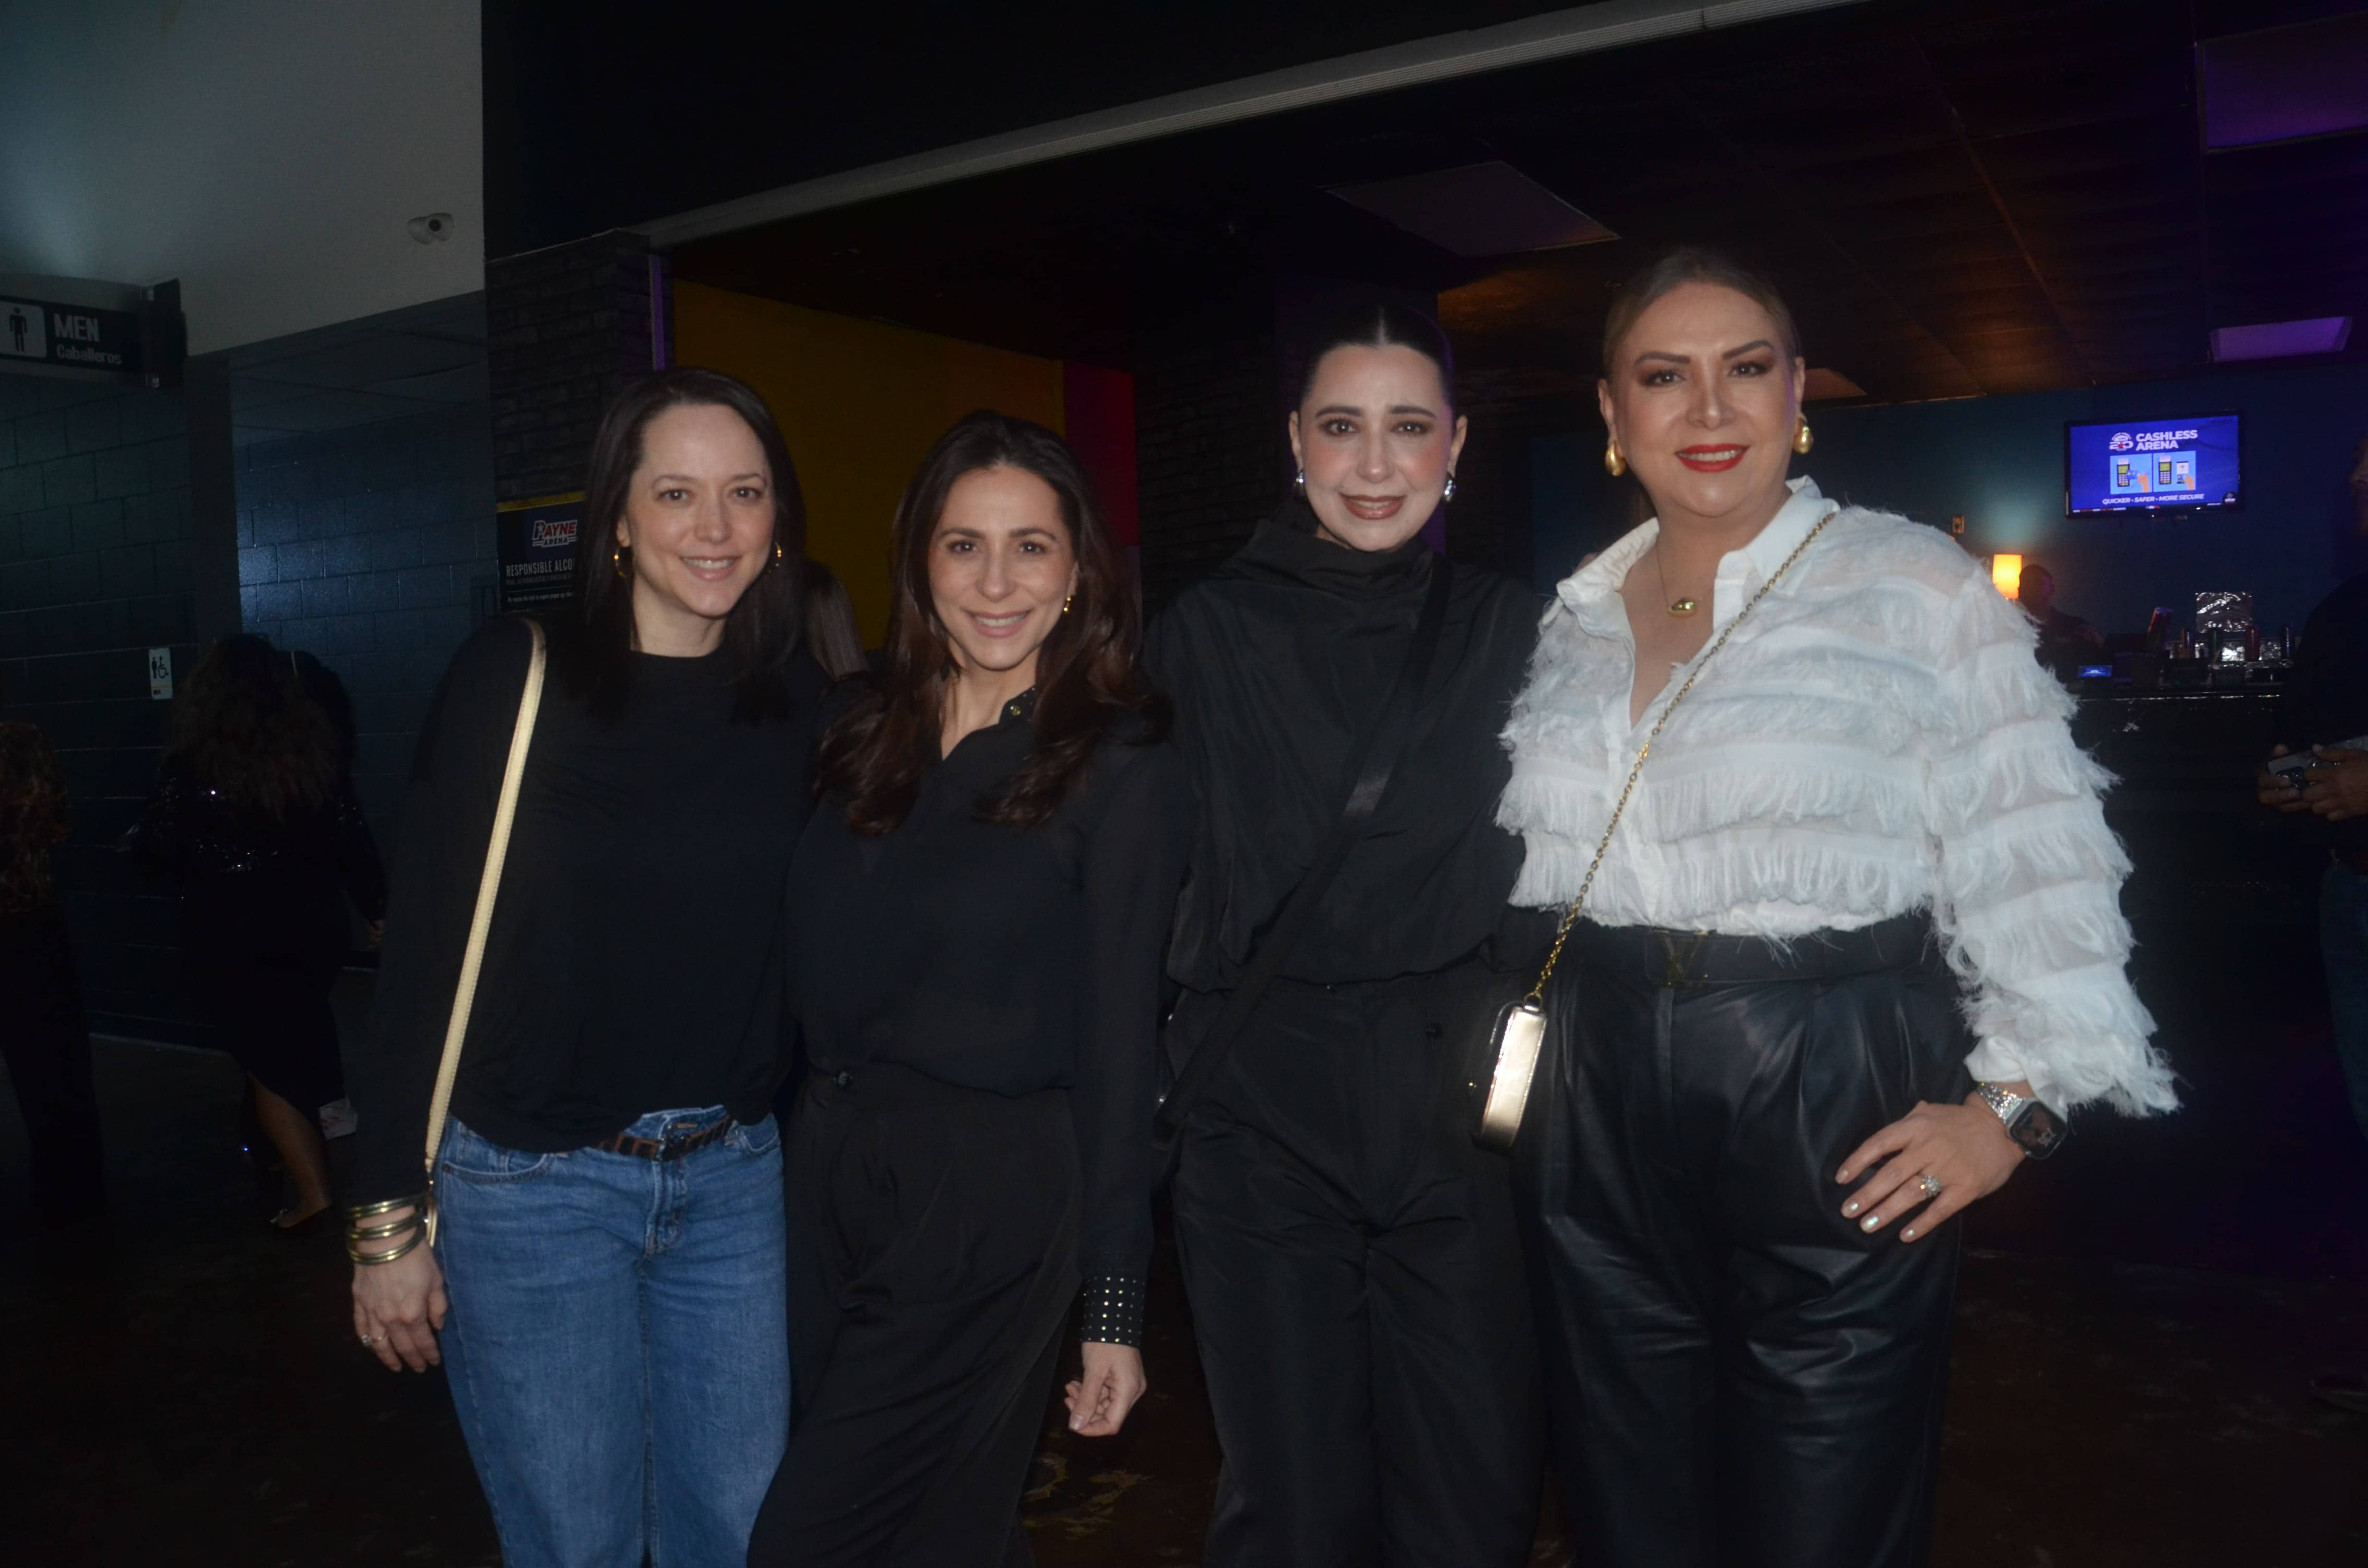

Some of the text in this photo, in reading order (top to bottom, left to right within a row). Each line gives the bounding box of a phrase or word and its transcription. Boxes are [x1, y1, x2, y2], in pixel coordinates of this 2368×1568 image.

[53, 312, 100, 343] MEN
[56, 343, 123, 365] Caballeros
[2136, 429, 2198, 441] CASHLESS
[2135, 440, 2179, 451] ARENA
[532, 519, 577, 540] PAYNE
[543, 537, 568, 546] ARENA
[506, 561, 553, 577] RESPONSIBLE
